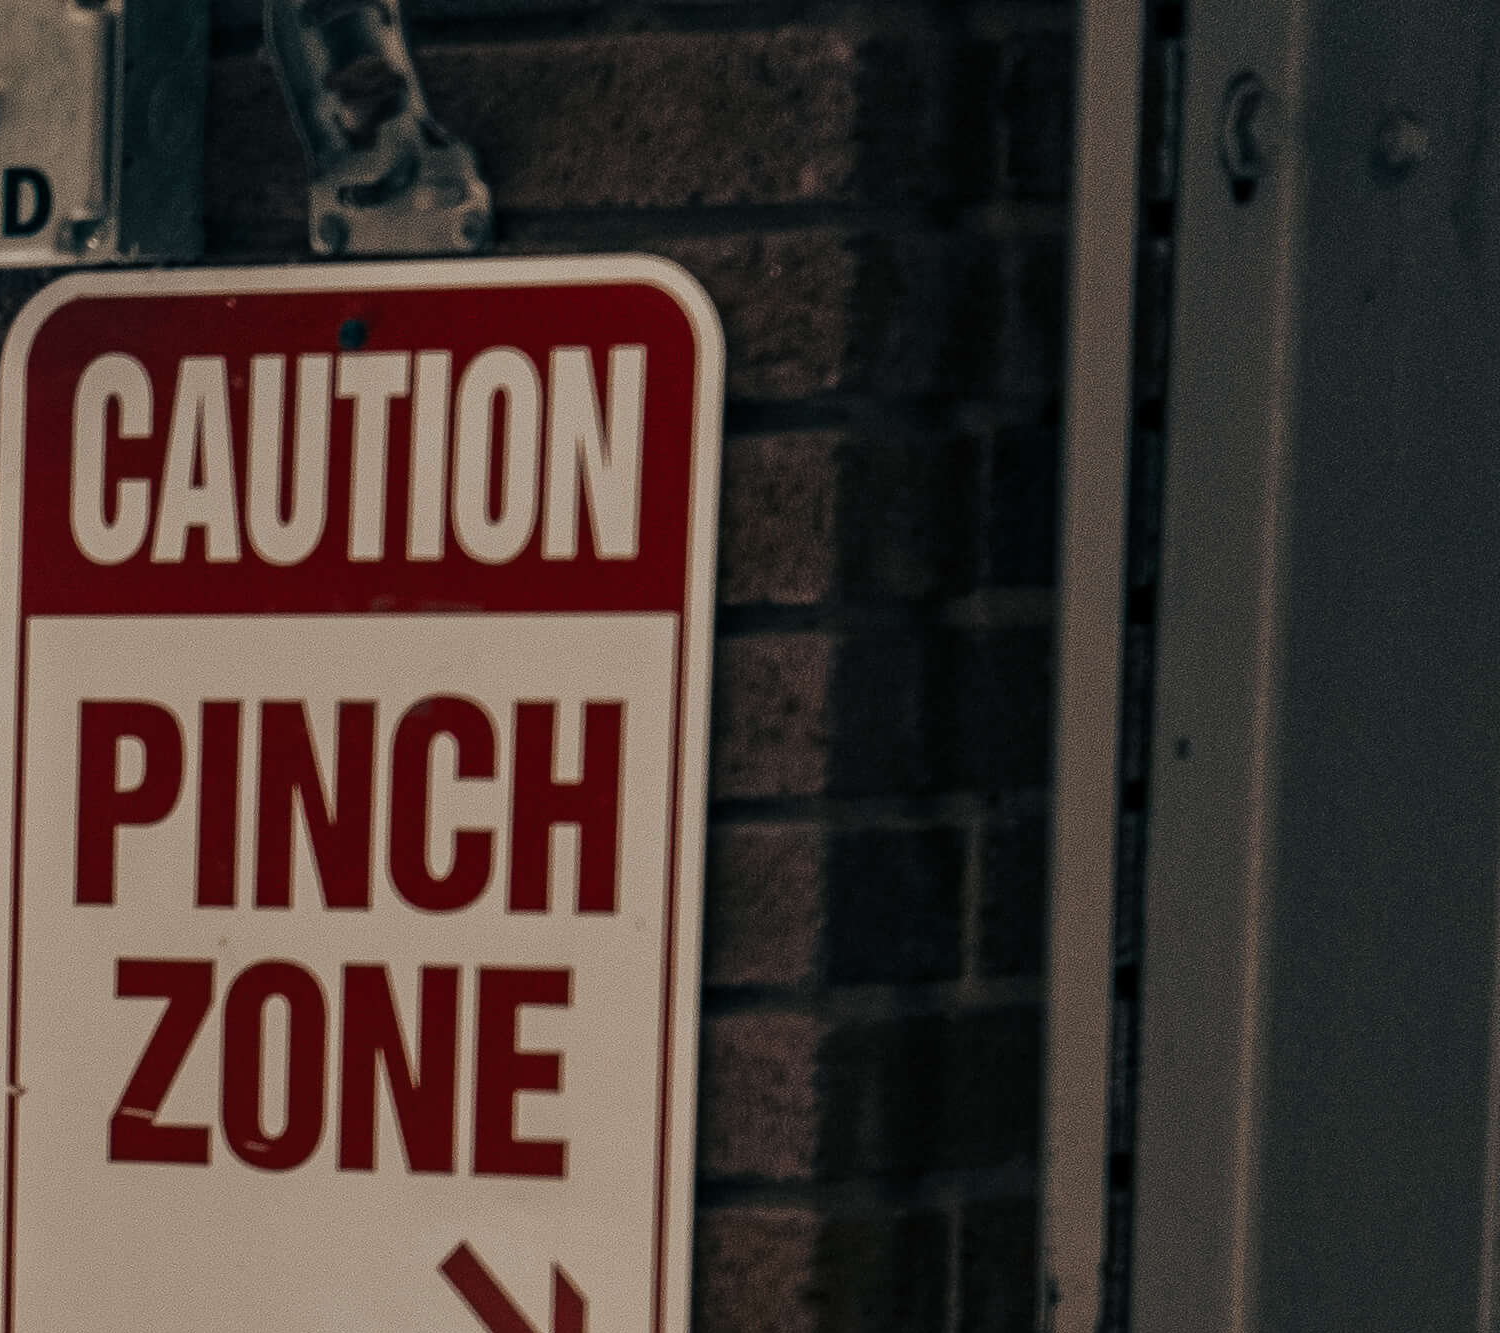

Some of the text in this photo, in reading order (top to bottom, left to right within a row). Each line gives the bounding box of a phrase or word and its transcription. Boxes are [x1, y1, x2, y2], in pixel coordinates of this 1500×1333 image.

[2, 166, 52, 238] D
[71, 345, 647, 565] CAUTION
[75, 695, 624, 914] PINCH
[110, 959, 572, 1178] ZONE
